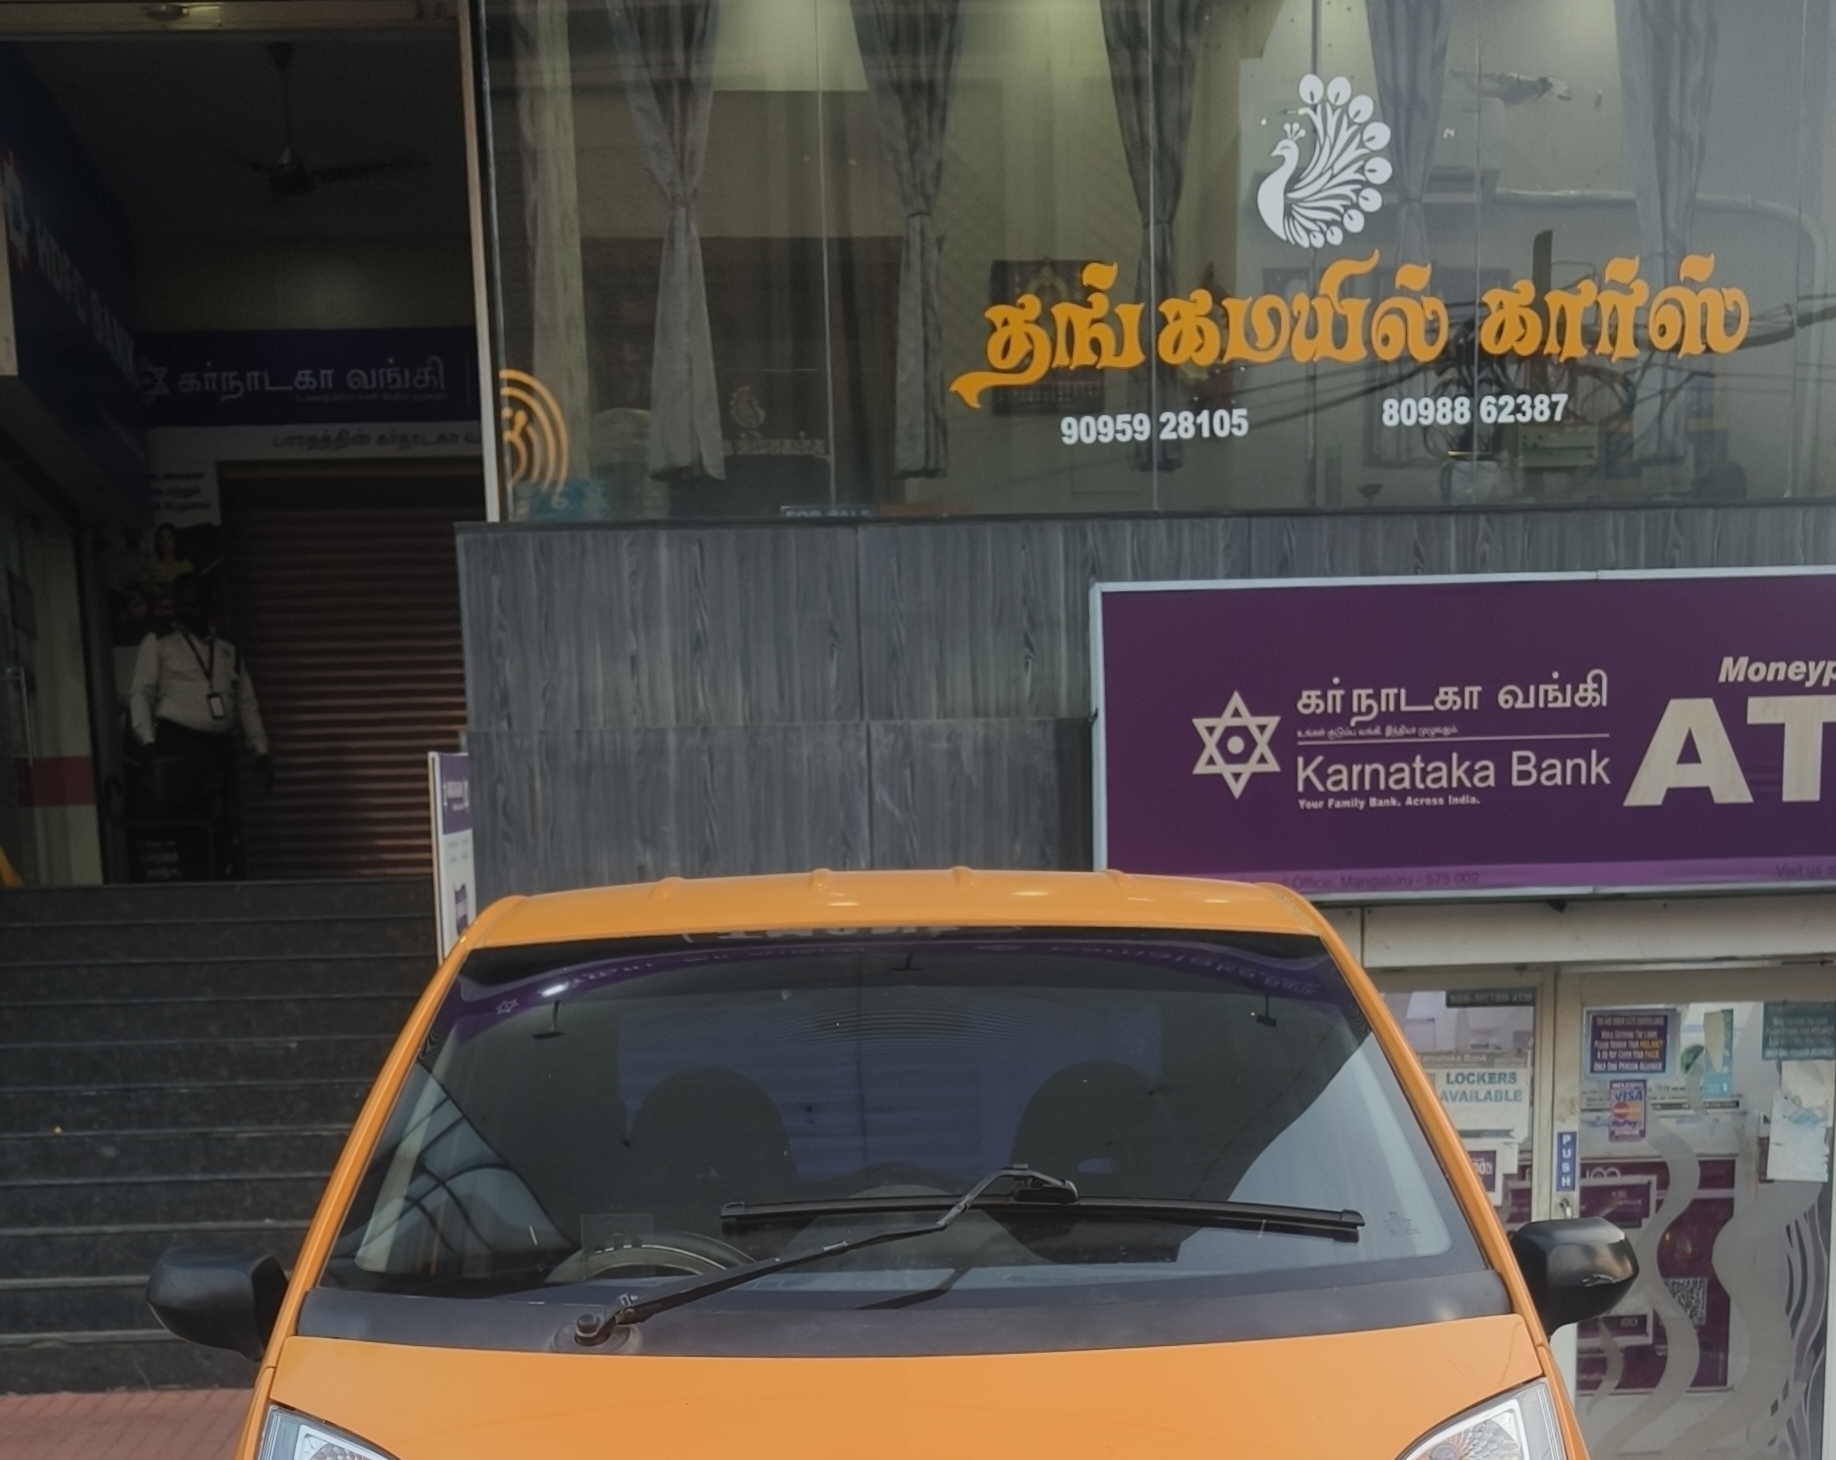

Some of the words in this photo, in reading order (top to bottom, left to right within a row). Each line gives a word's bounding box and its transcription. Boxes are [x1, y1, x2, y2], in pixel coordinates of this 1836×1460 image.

[1480, 254, 1750, 363] கார்ஸ்
[178, 362, 335, 402] கர்நாடகா
[346, 356, 446, 391] வங்கி
[1060, 413, 1150, 445] 90959
[1159, 408, 1249, 440] 28105
[1382, 396, 1471, 426] 80988
[1480, 393, 1568, 424] 62387
[1297, 676, 1482, 727] கர்நாடகா
[1497, 669, 1608, 710] வங்கி
[1297, 752, 1495, 792] Karnataka
[1510, 750, 1611, 788] Bank
[1298, 799, 1324, 810] Your
[1328, 796, 1366, 810] Family
[1405, 795, 1444, 807] Across
[1440, 1090, 1523, 1103] AVAILABLE
[1446, 1072, 1517, 1085] LOCKERS
[1615, 1090, 1643, 1102] VISA
[1561, 1134, 1572, 1187] PUSH
